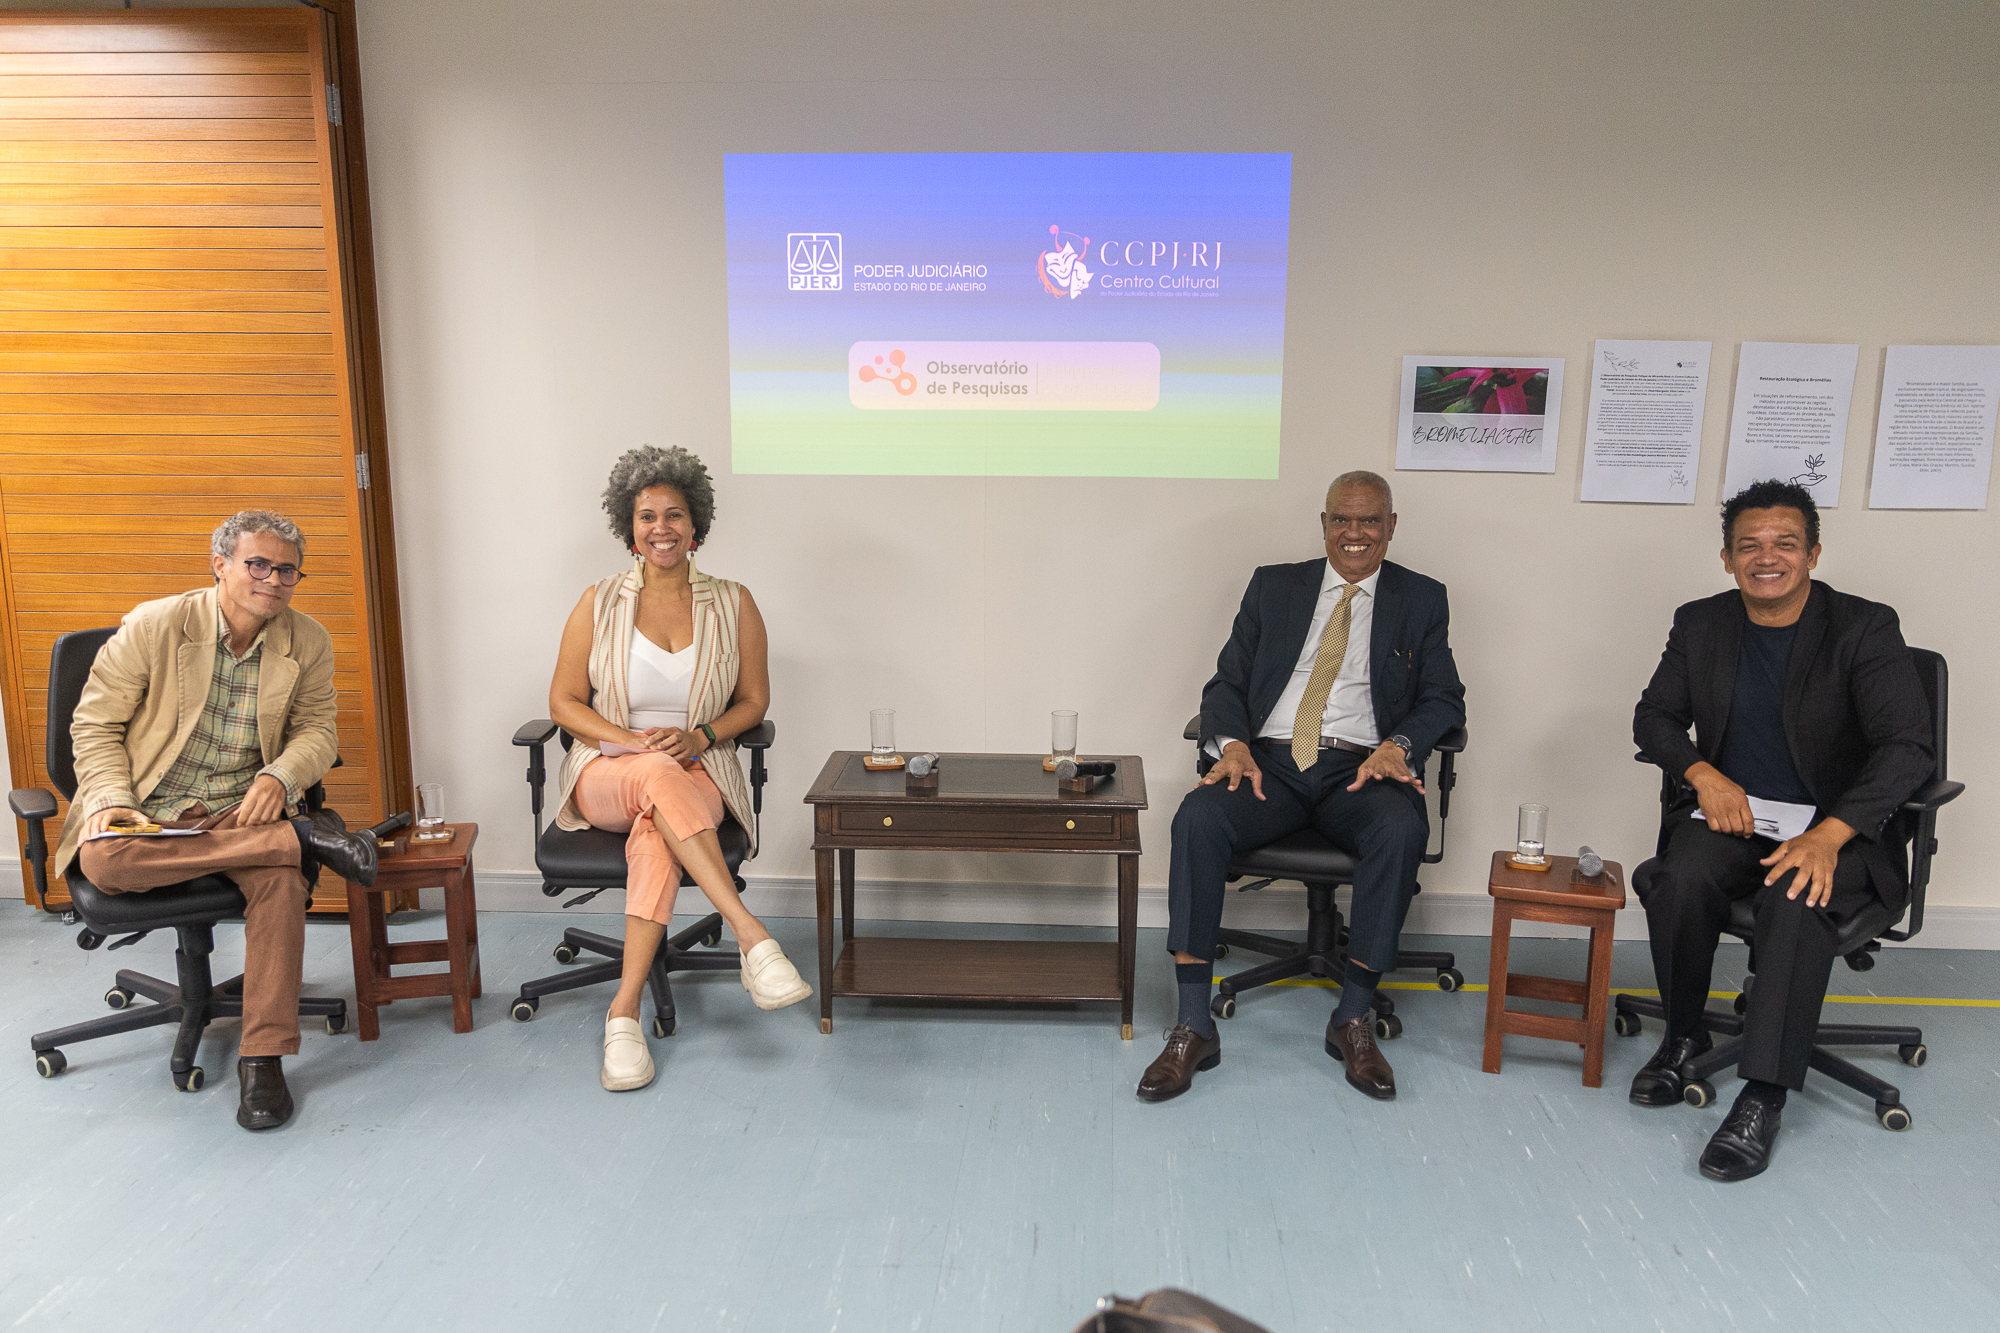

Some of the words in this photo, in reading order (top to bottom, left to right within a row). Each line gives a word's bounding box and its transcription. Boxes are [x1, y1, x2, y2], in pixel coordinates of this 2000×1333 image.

[854, 264, 904, 278] PODER
[907, 262, 988, 278] JUDICIÁRIO
[790, 276, 840, 289] PJERJ
[854, 282, 891, 291] ESTADO
[894, 282, 908, 291] DO
[910, 282, 926, 291] RIO
[930, 282, 942, 291] DE
[945, 282, 986, 291] JANEIRO
[1100, 274, 1154, 288] Centro
[1159, 275, 1219, 289] Cultural
[926, 360, 1028, 375] Observatório
[926, 381, 947, 394] de
[952, 382, 1028, 397] Pesquisas
[1412, 426, 1543, 445] BROMELIACEAE
